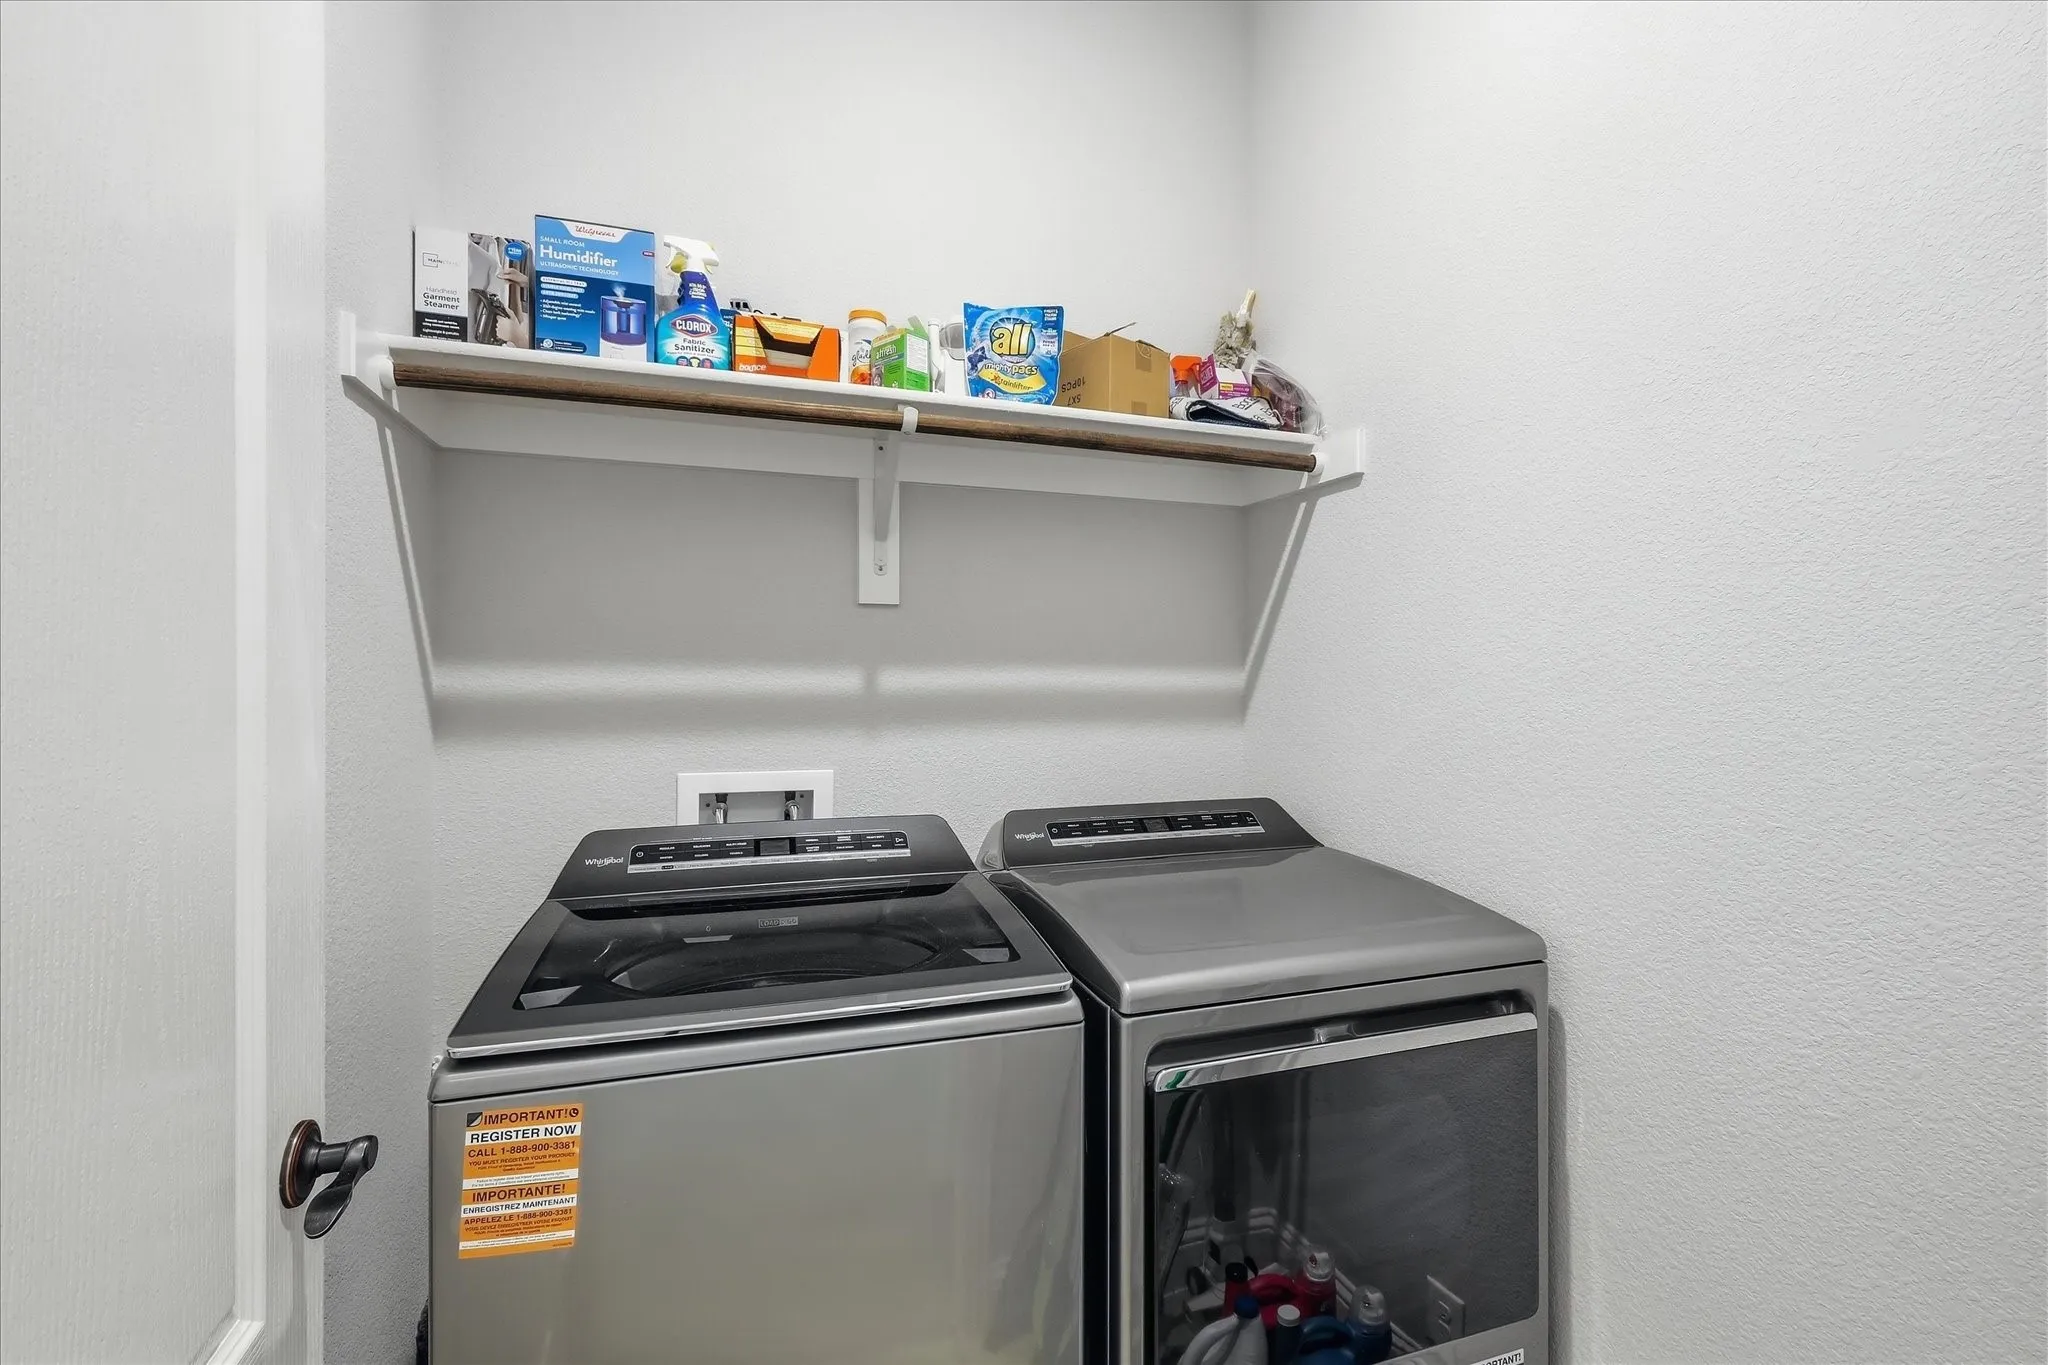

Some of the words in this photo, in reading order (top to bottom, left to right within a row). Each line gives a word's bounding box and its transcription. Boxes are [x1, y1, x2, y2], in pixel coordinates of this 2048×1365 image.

[540, 236, 562, 245] SMALL
[563, 239, 585, 247] ROOM
[540, 244, 618, 267] Humidifier
[540, 260, 578, 271] ULTRASONIC
[579, 265, 619, 276] TECHNOLOGY
[423, 292, 460, 303] Garment
[426, 286, 458, 296] Handheld
[424, 299, 460, 310] Steamer
[676, 320, 711, 333] CLOROX
[683, 338, 706, 347] Fabric
[991, 323, 1032, 356] all
[674, 344, 715, 355] Sanitizer
[851, 350, 871, 367] glad
[985, 362, 1012, 373] mighty
[1012, 364, 1038, 376] pacs
[1061, 376, 1085, 393] 10PCS
[1015, 831, 1045, 841] Whirlpool
[585, 857, 624, 868] Whirlpool
[484, 1108, 568, 1126] IMPORTANT!
[470, 1128, 540, 1143] REGISTER
[544, 1125, 577, 1140] NOW
[468, 1148, 497, 1158] CALL
[501, 1141, 576, 1155] 1-888-900-3381
[500, 1156, 530, 1164] REGISTER
[530, 1154, 547, 1162] YOUR
[472, 1183, 566, 1202] IMPORTANTE!
[463, 1203, 520, 1214] ENREGISTREZ
[522, 1196, 575, 1209] MAINTENANT
[464, 1215, 502, 1225] APPELEZ
[503, 1214, 514, 1222] LE
[516, 1208, 572, 1221] 1-888-900-3381
